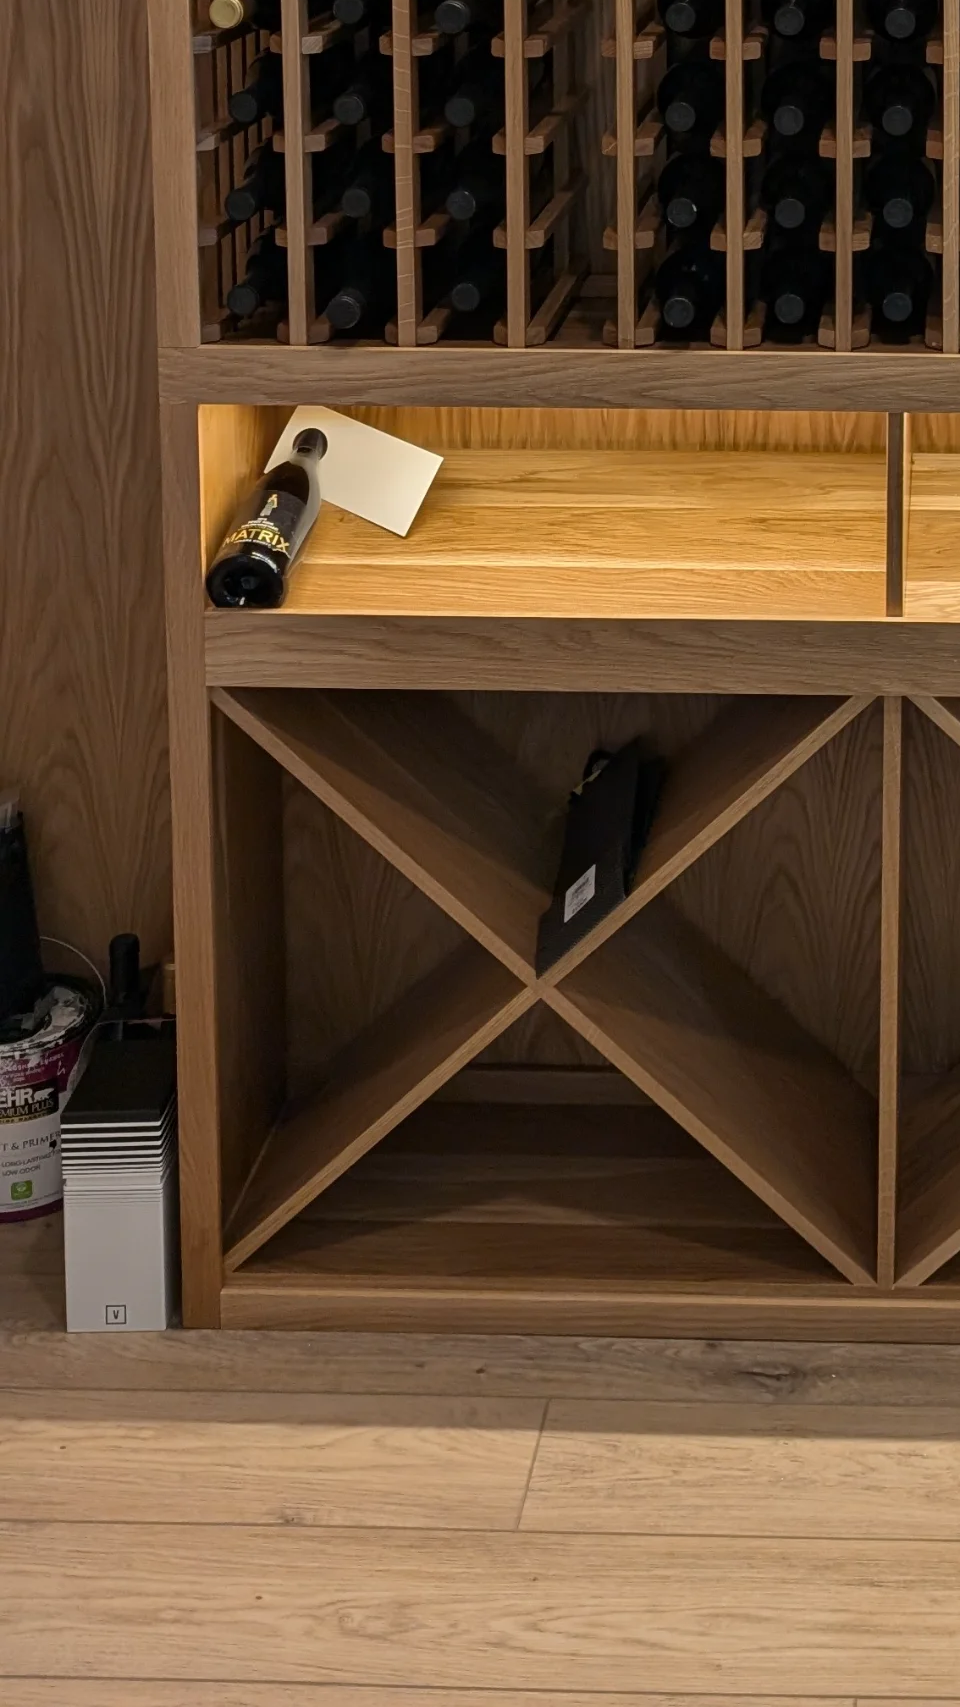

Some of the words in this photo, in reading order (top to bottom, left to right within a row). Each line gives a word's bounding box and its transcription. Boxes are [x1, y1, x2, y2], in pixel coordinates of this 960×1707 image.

[222, 528, 290, 552] MATRIX
[0, 1105, 29, 1117] MIUM
[31, 1099, 54, 1113] PLUS
[11, 1141, 19, 1151] &
[22, 1130, 62, 1149] PRIMER
